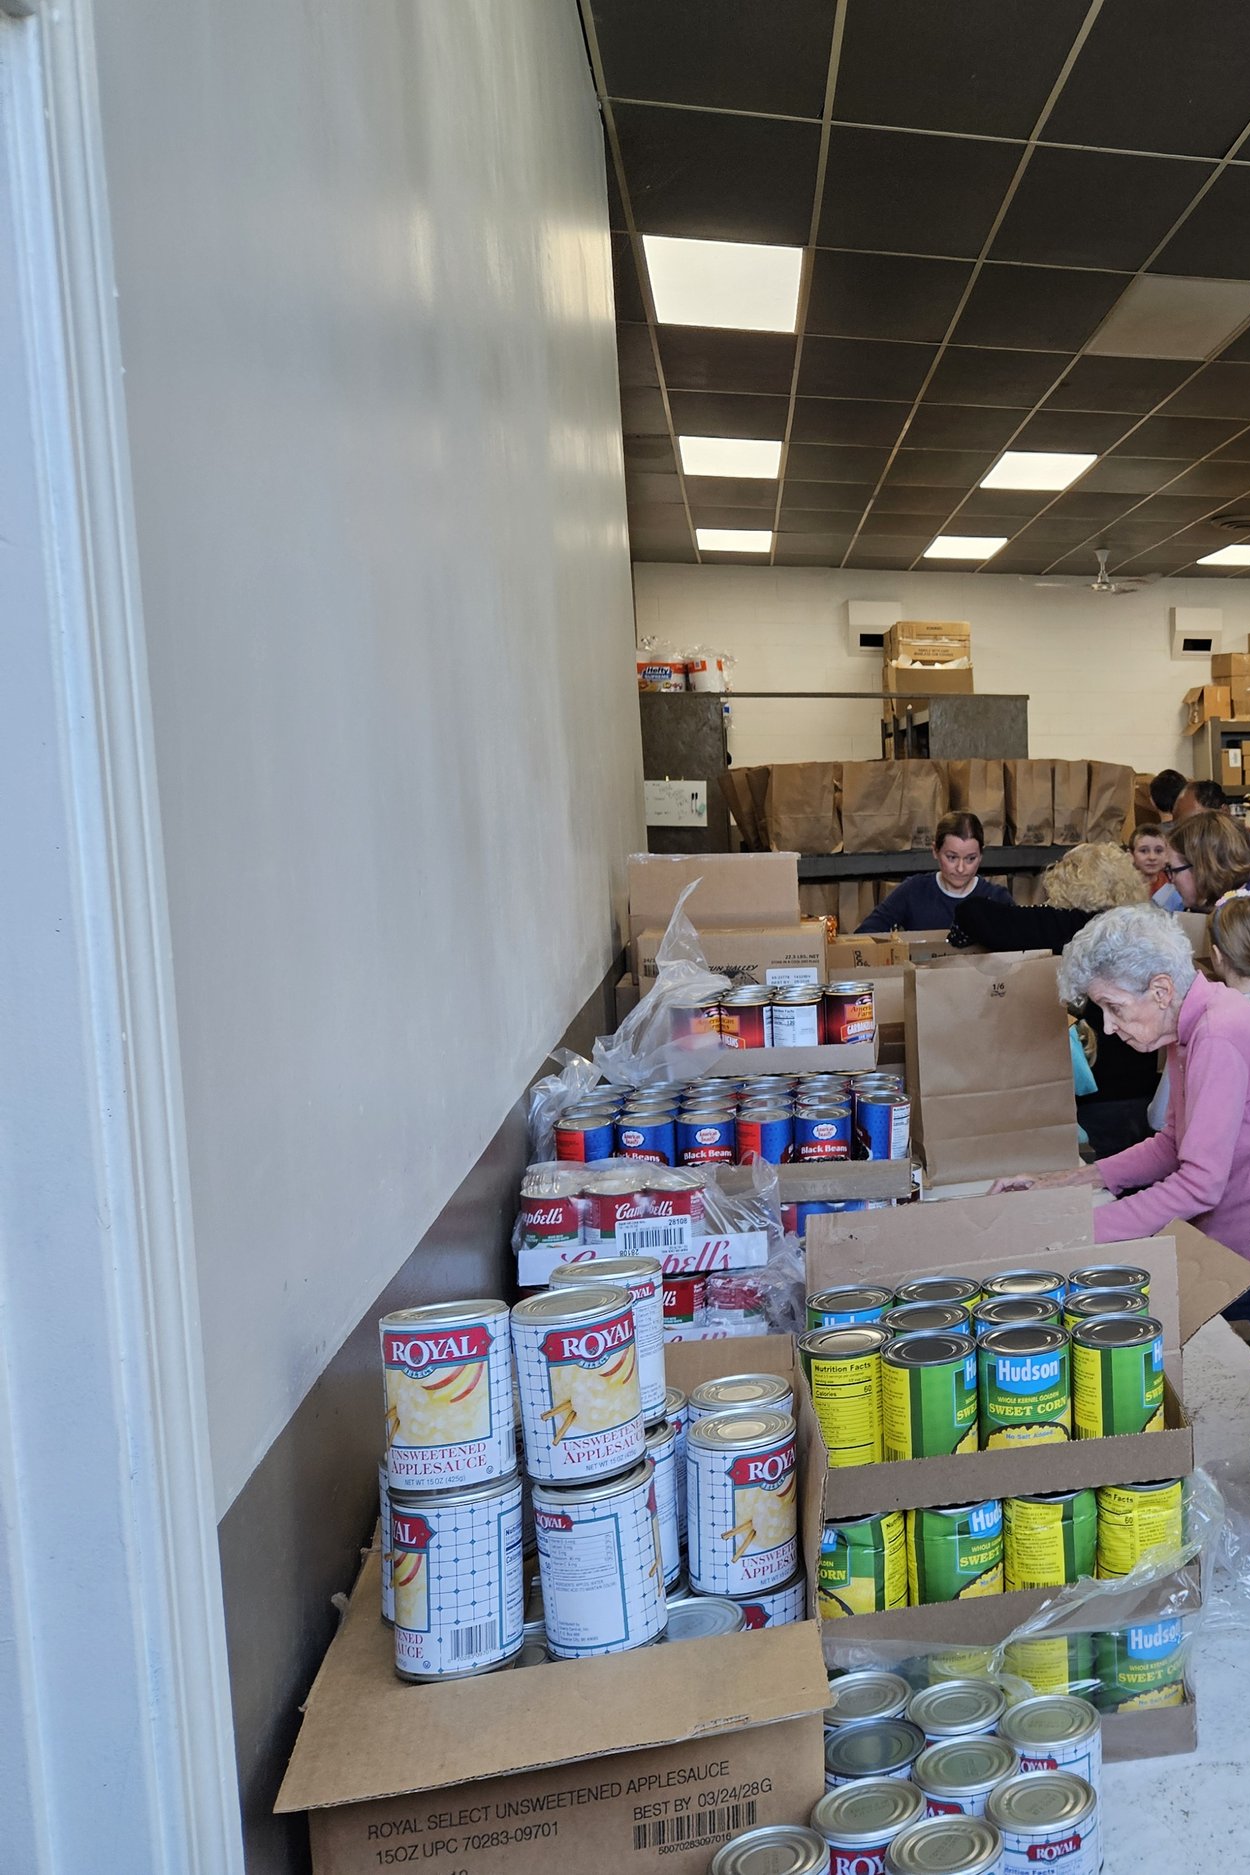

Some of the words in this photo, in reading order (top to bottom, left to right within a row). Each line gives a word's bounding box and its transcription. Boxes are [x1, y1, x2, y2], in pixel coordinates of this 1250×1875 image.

[632, 1152, 660, 1162] Beans
[683, 1149, 711, 1161] Black
[713, 1149, 732, 1158] Beans
[800, 1144, 824, 1154] Black
[825, 1144, 848, 1152] Beans
[668, 1217, 688, 1226] 28108
[630, 1286, 652, 1302] OYAL
[561, 1319, 633, 1359] ROYAL
[391, 1335, 478, 1368] ROYAL
[578, 1355, 609, 1368] SELECT
[814, 1364, 847, 1373] Nutrition
[850, 1362, 871, 1371] Facts
[998, 1358, 1059, 1383] Hudson
[403, 1366, 435, 1379] SELECT
[956, 1403, 977, 1421] SWE
[988, 1404, 1033, 1417] SWEET
[1037, 1396, 1067, 1414] CORN
[562, 1419, 644, 1452] UNSWEETENE
[390, 1442, 487, 1462] UNSWEETENED
[391, 1454, 487, 1476] APPLESAUCE
[586, 1463, 598, 1471] NET
[748, 1442, 797, 1482] ROYA
[761, 1476, 786, 1491] SELECT
[1113, 1494, 1134, 1504] Facts
[536, 1512, 566, 1530] ROYAL
[971, 1499, 1002, 1533] Hud
[819, 1569, 846, 1581] ORN
[1118, 1669, 1164, 1684] SWEET
[1020, 1759, 1051, 1772] OYAL
[367, 1818, 423, 1841] ROYAL
[427, 1806, 489, 1830] SELECT
[495, 1782, 622, 1820] UNSWEETENED
[625, 1760, 730, 1796] APPLESAUCE
[633, 1803, 670, 1822] BEST
[674, 1798, 691, 1815] BY
[697, 1778, 772, 1808] 03/24/28G
[376, 1844, 420, 1866] 15OZ
[422, 1838, 458, 1859] UPC
[462, 1821, 559, 1852] 70283-09701
[658, 1832, 733, 1856] 50070283097016
[1036, 1840, 1077, 1860] ROYAL
[835, 1855, 886, 1875] ROY
